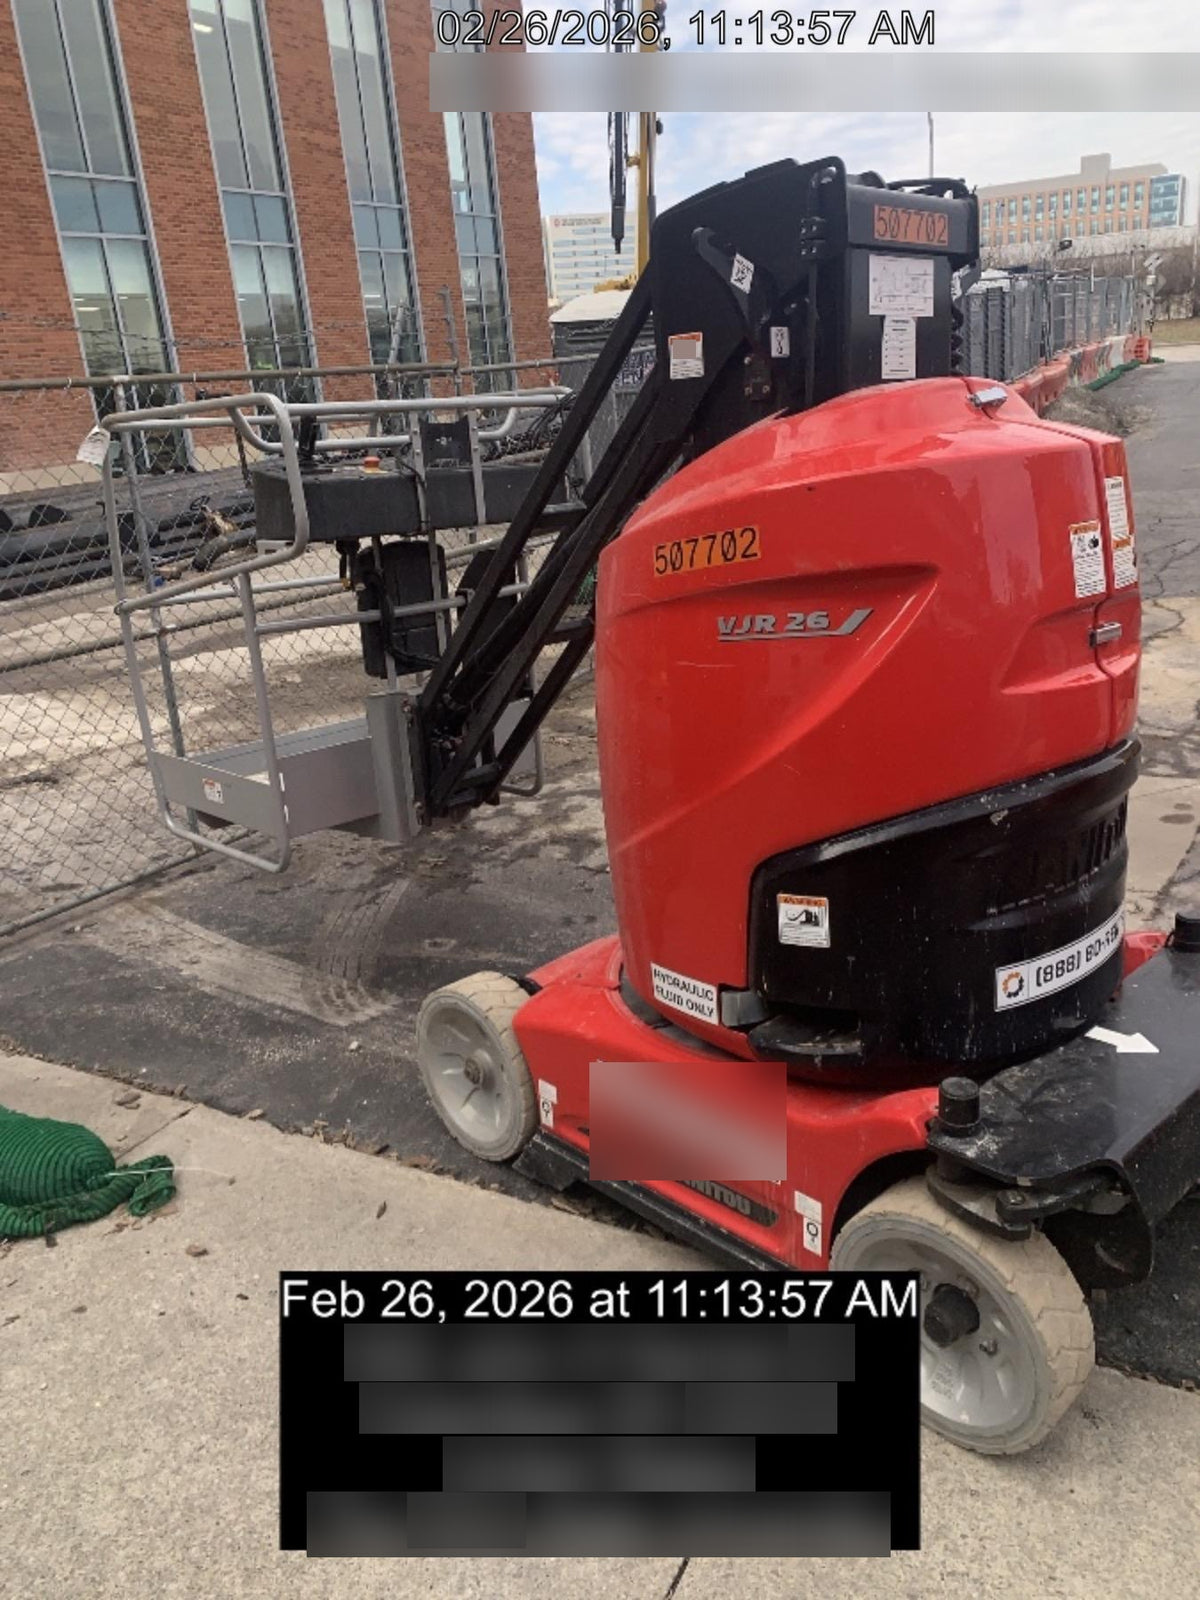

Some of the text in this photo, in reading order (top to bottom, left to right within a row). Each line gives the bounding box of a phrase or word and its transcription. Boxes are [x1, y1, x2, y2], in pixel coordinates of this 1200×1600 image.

[876, 207, 948, 244] 507702
[654, 527, 759, 575] 507702
[717, 611, 829, 635] VJR 26
[653, 967, 714, 1002] HYDRAULIC
[1035, 950, 1081, 987] (888)
[655, 984, 714, 1018] FLUID ONLY
